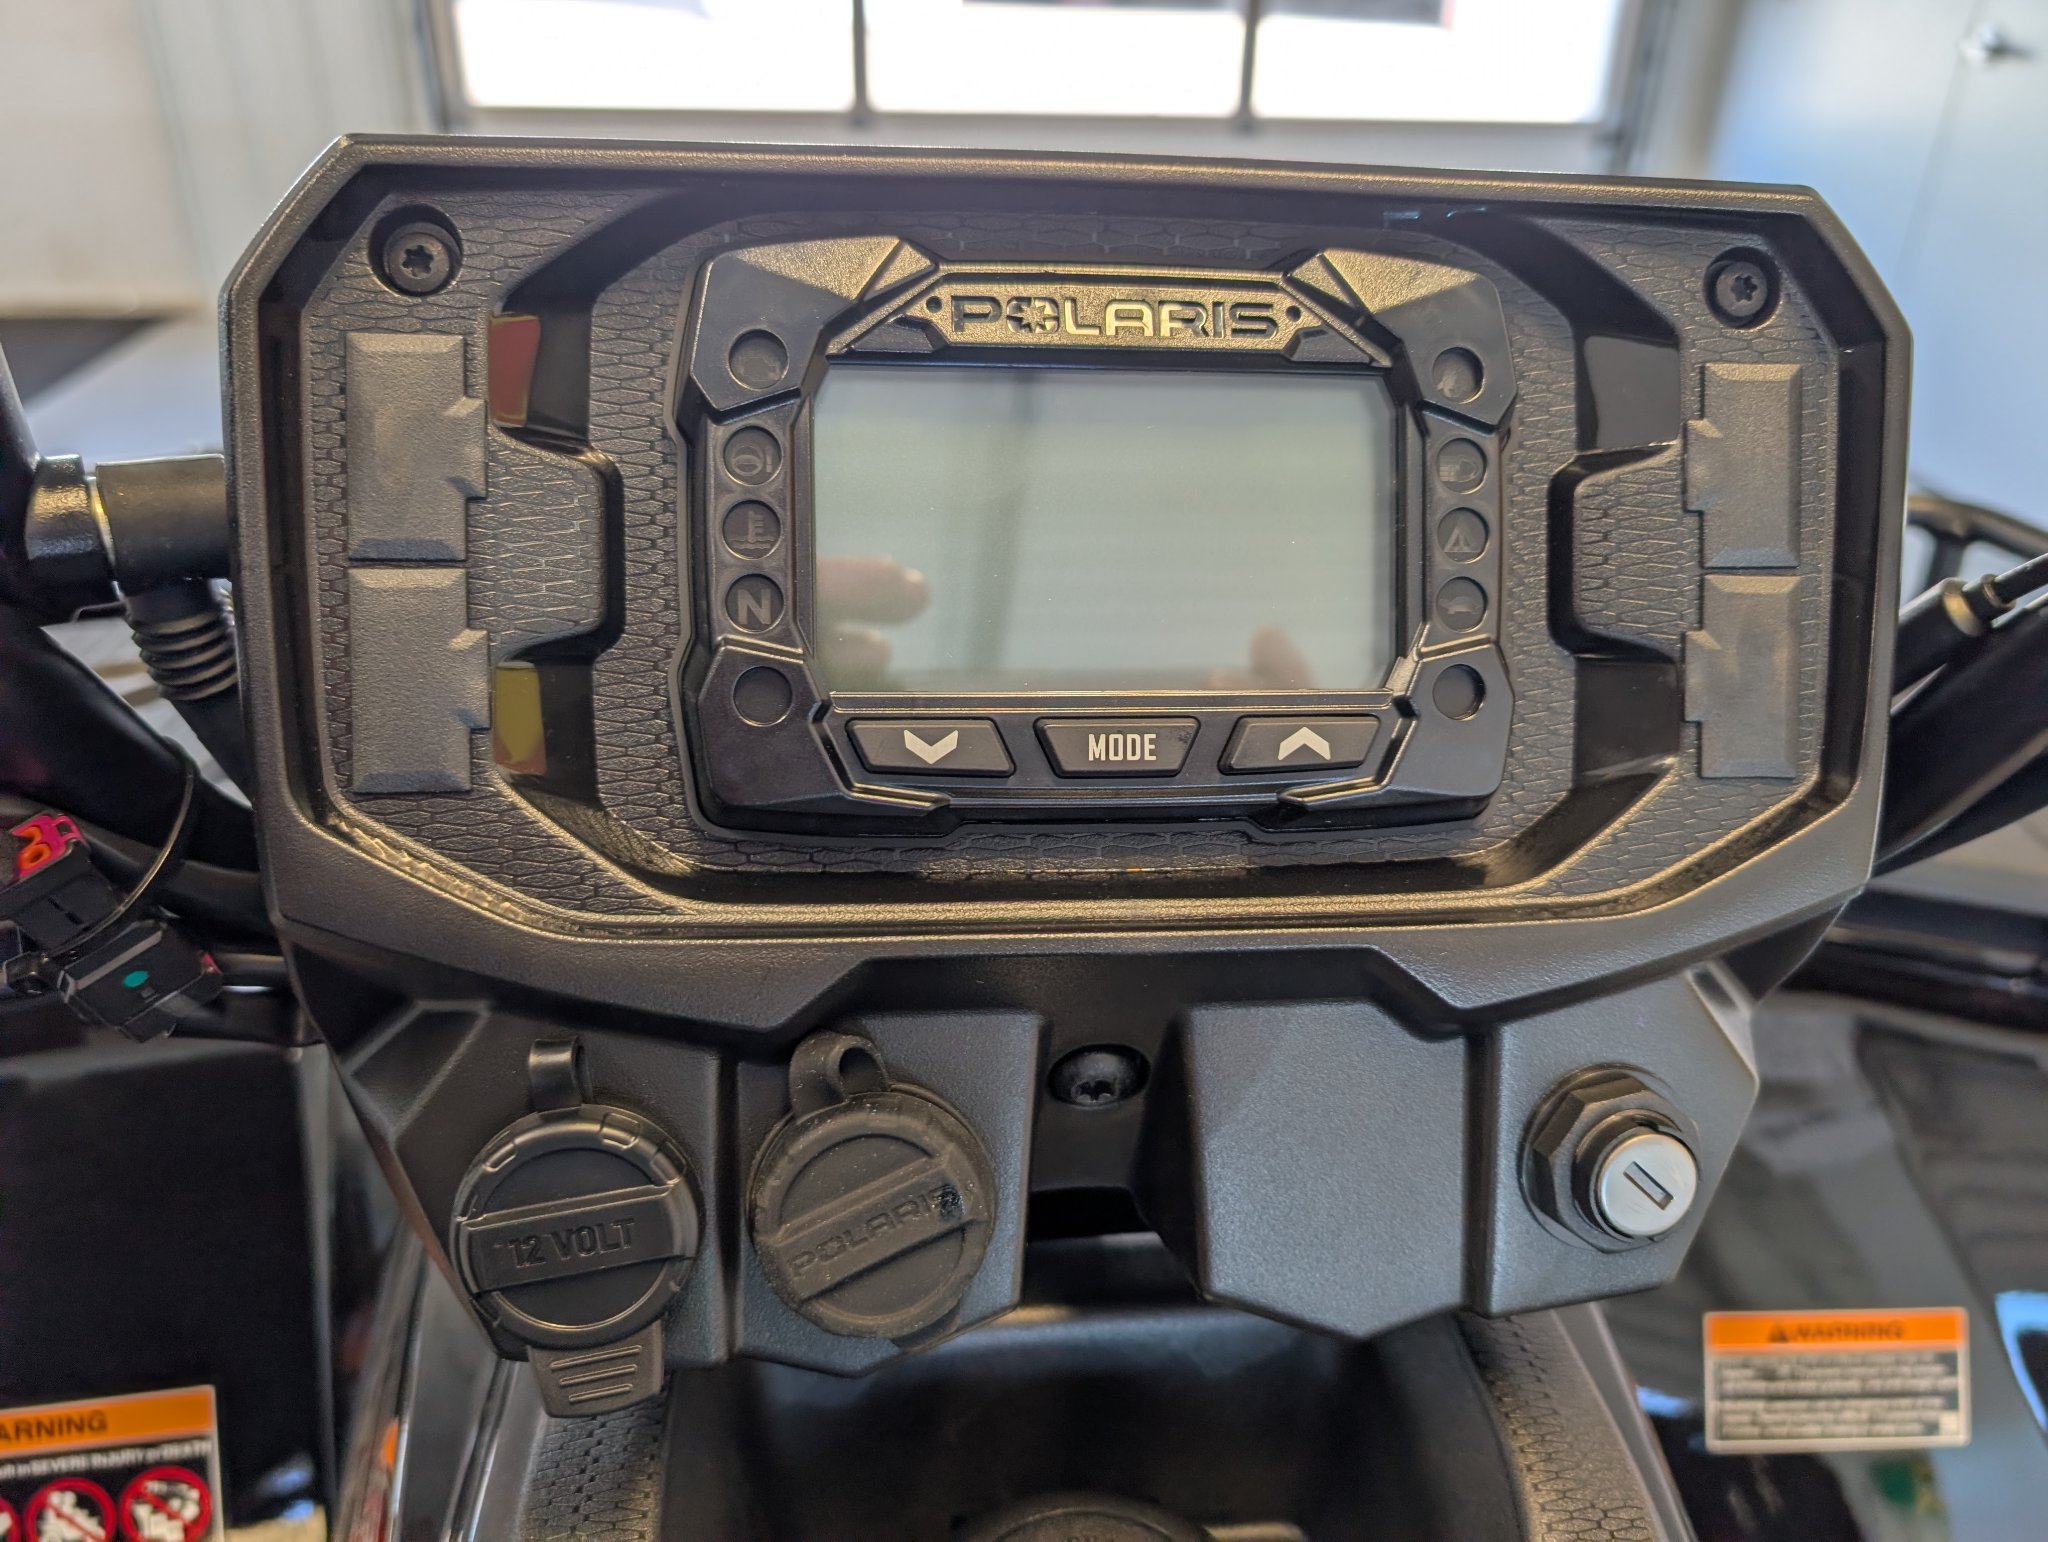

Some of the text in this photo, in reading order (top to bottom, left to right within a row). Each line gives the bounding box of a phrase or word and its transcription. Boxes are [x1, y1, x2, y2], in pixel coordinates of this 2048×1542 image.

[951, 295, 1279, 339] POLARIS
[736, 587, 772, 626] N
[1087, 733, 1157, 761] MODE
[507, 1218, 636, 1268] 12 VOLT
